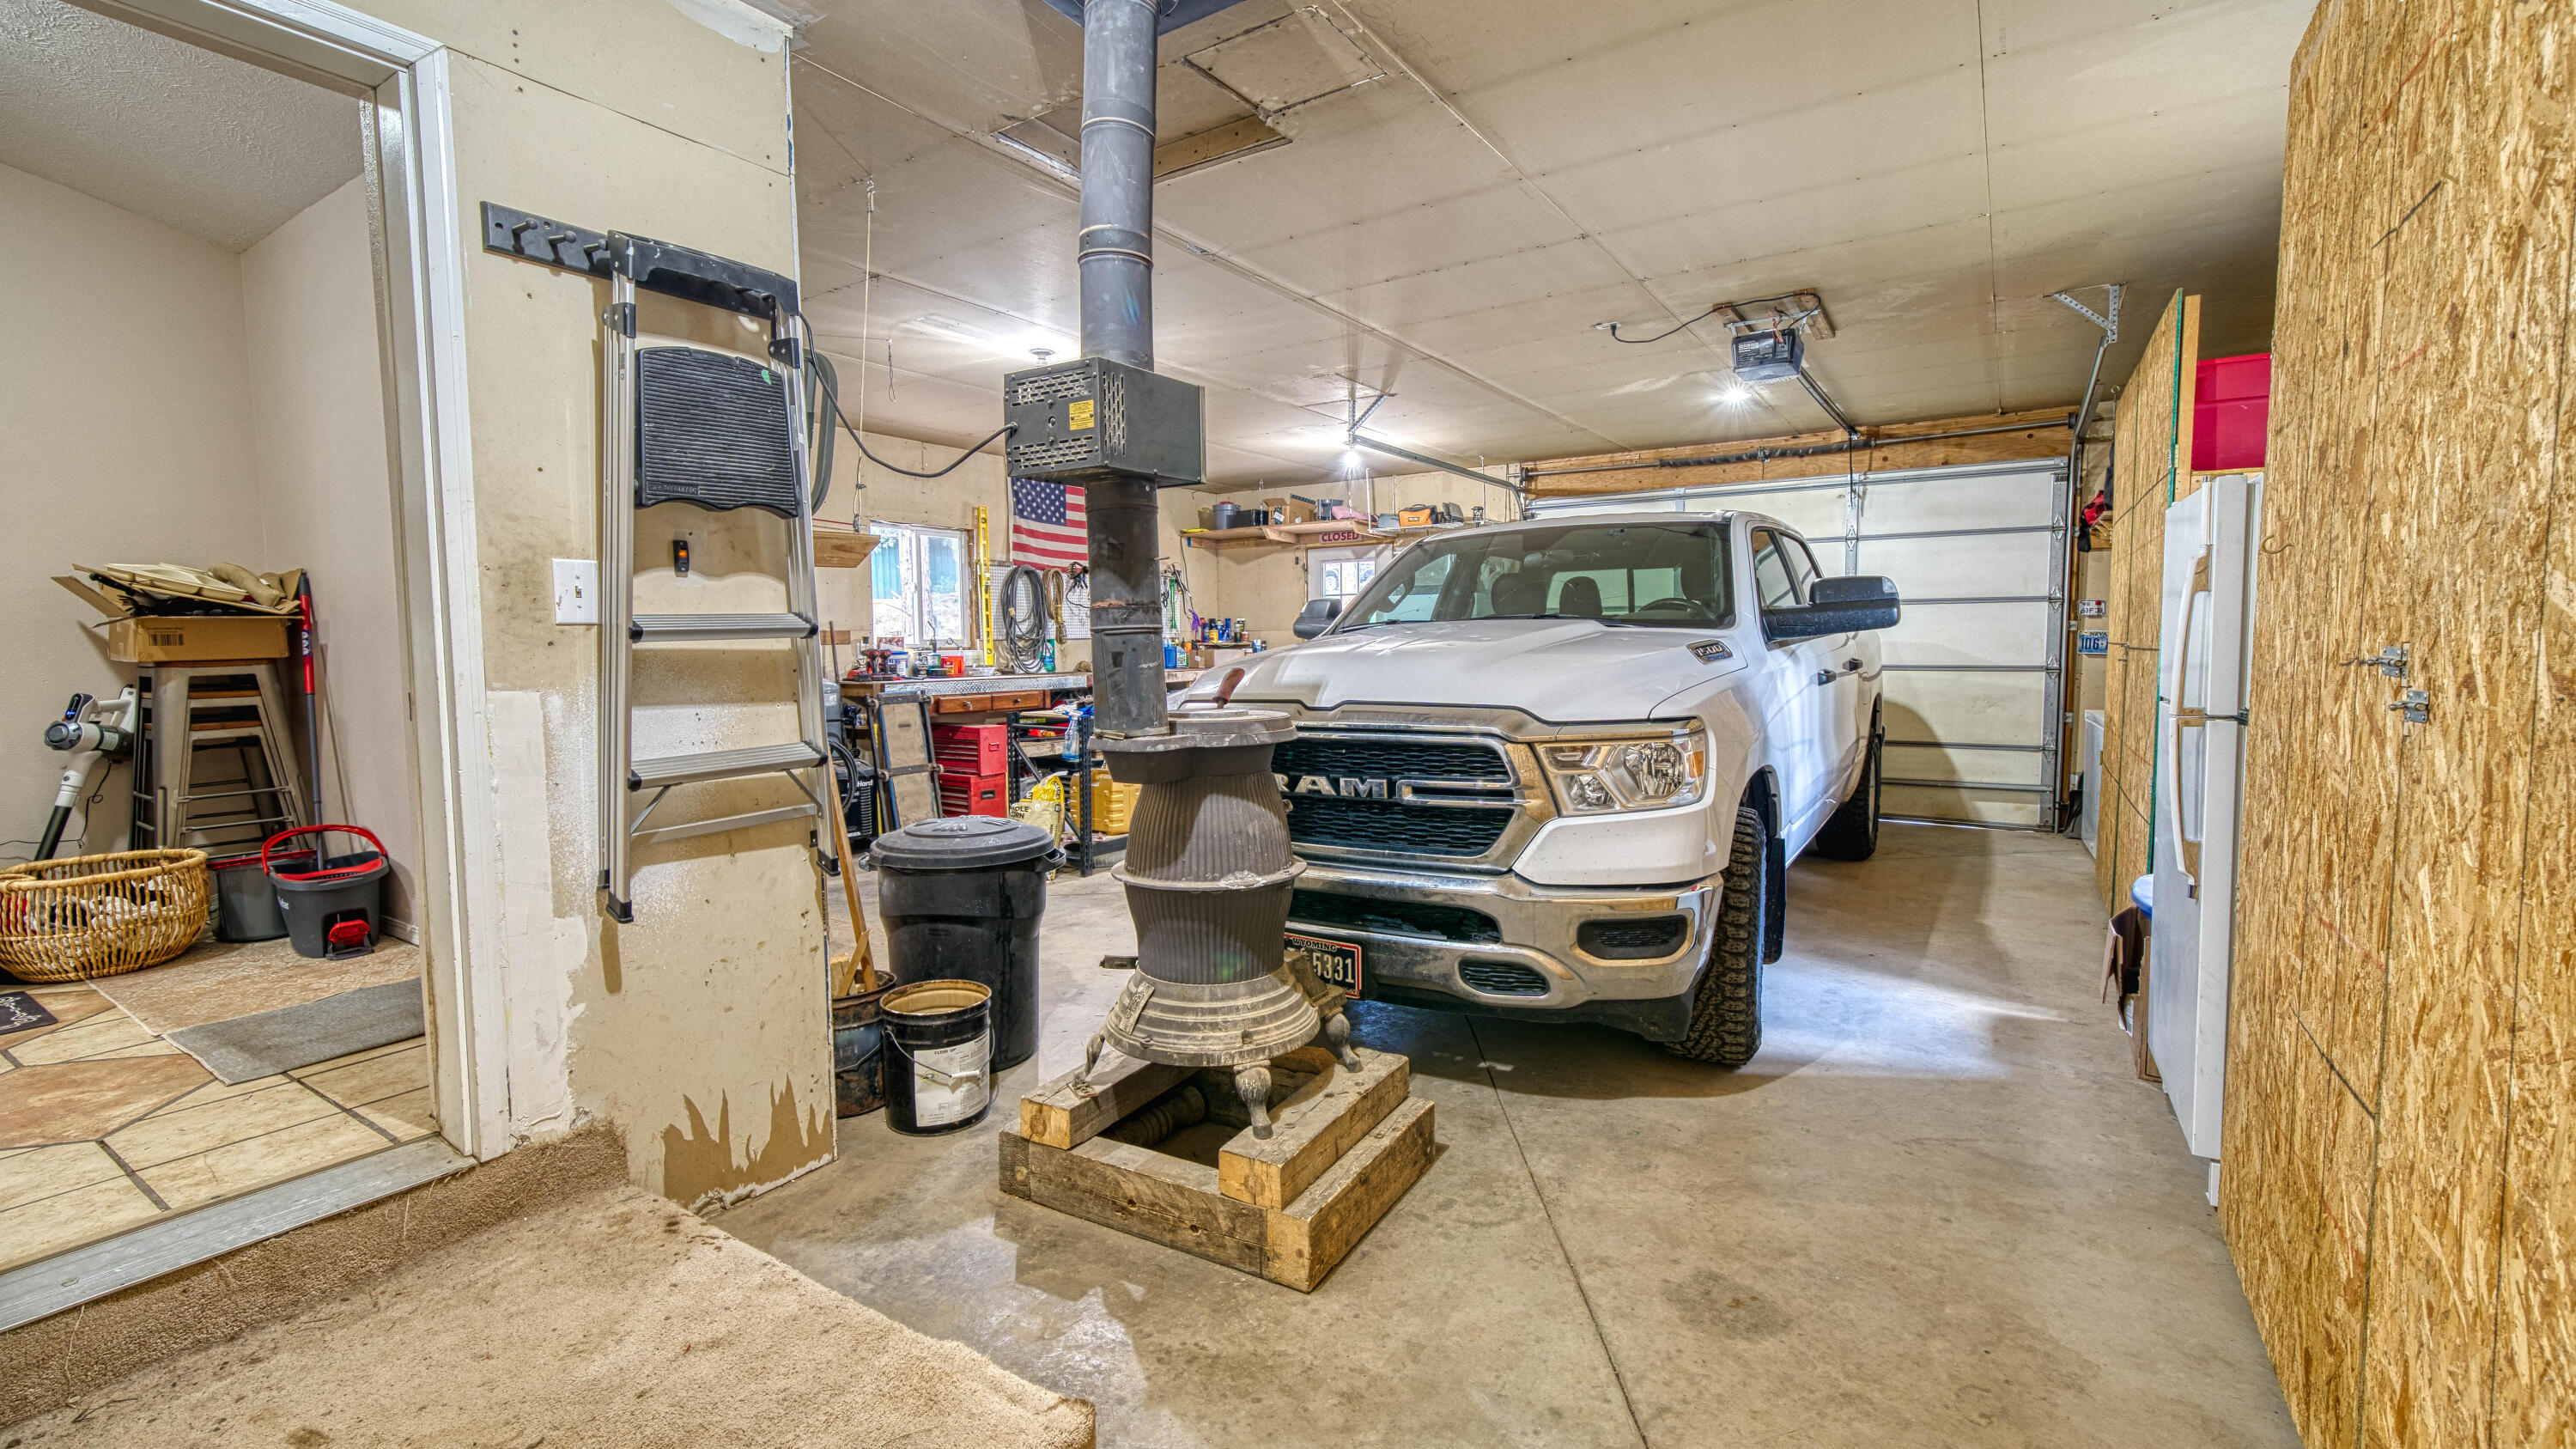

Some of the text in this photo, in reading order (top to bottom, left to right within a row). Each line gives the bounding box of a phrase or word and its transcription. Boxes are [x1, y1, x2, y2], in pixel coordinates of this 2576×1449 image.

[1321, 532, 1359, 542] CLOSED
[1696, 645, 1723, 656] 1500
[1273, 772, 1388, 799] RAM
[1291, 937, 1337, 953] WYOMING
[1312, 952, 1355, 983] 5331
